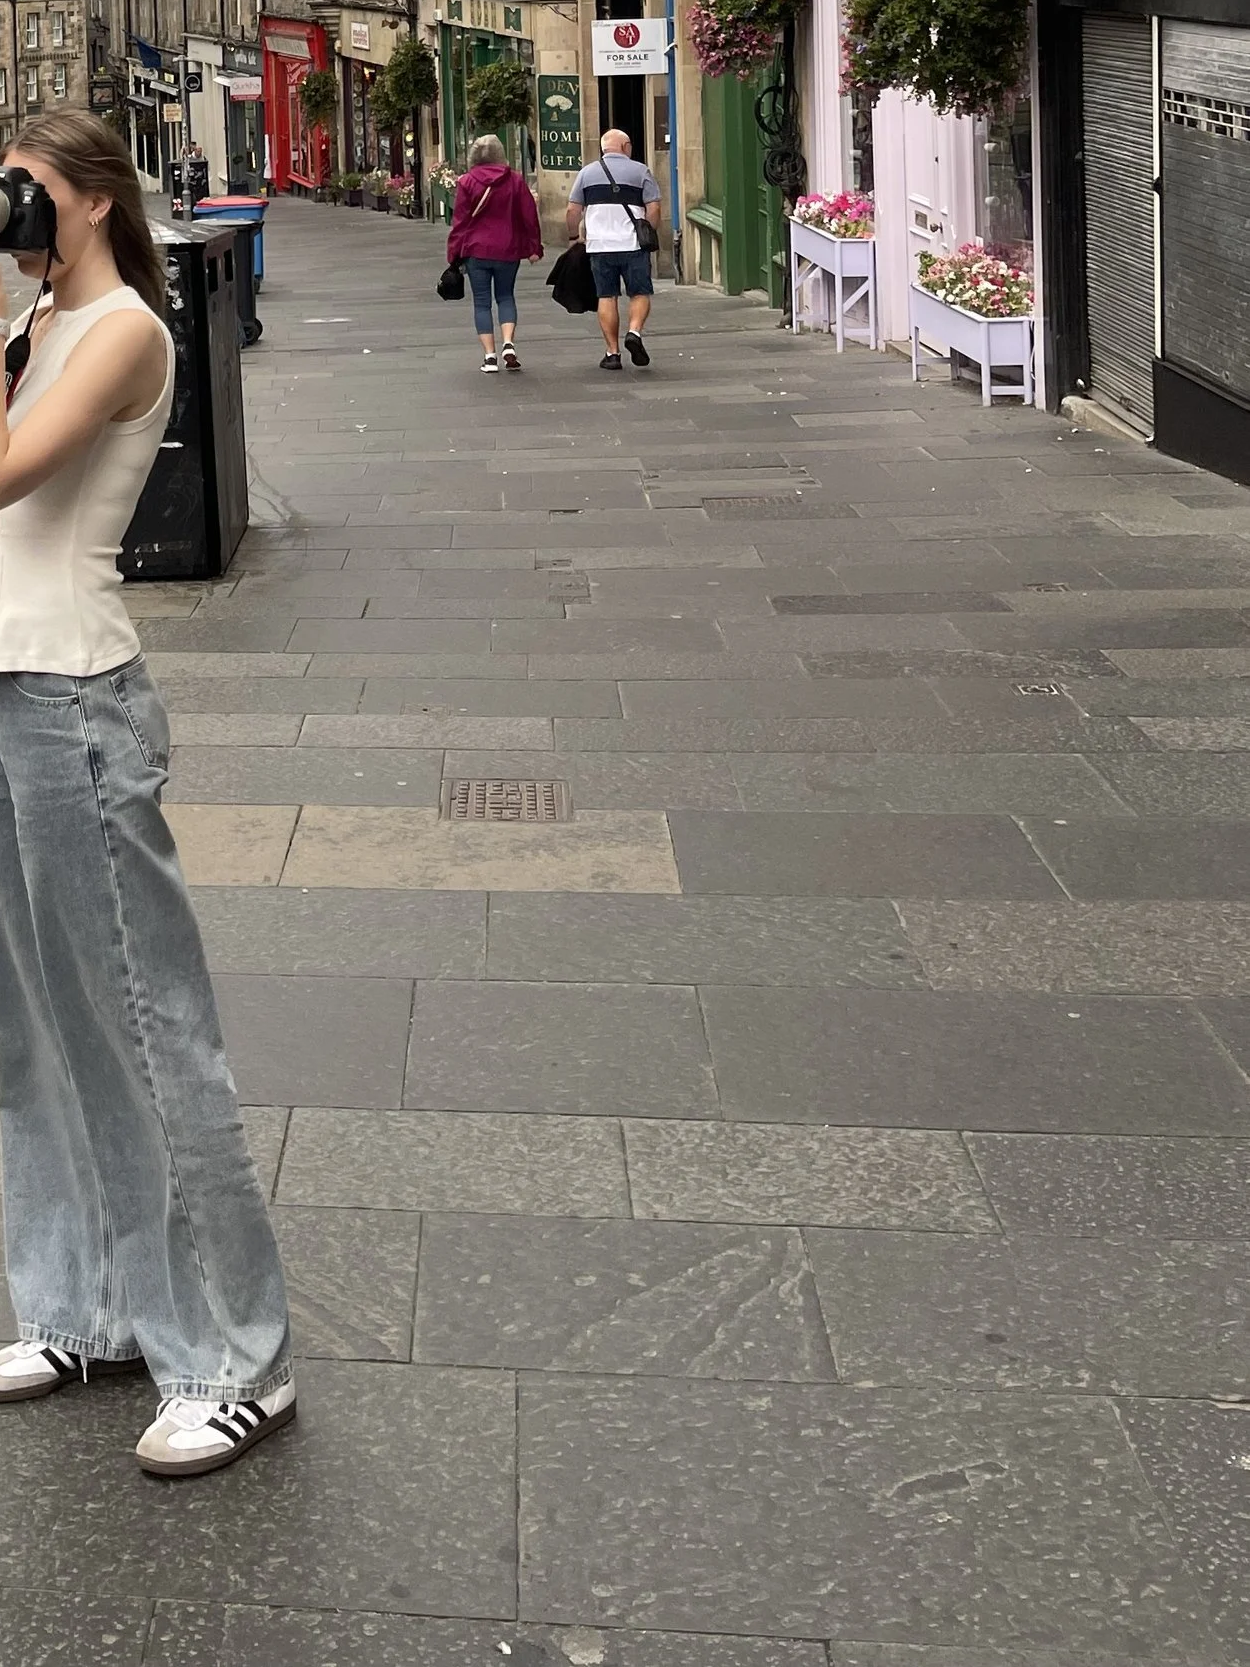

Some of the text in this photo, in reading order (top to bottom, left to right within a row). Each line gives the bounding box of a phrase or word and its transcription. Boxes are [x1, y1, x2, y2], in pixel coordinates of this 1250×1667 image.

[606, 53, 650, 62] FOR SALE
[541, 154, 583, 167] GIFTS
